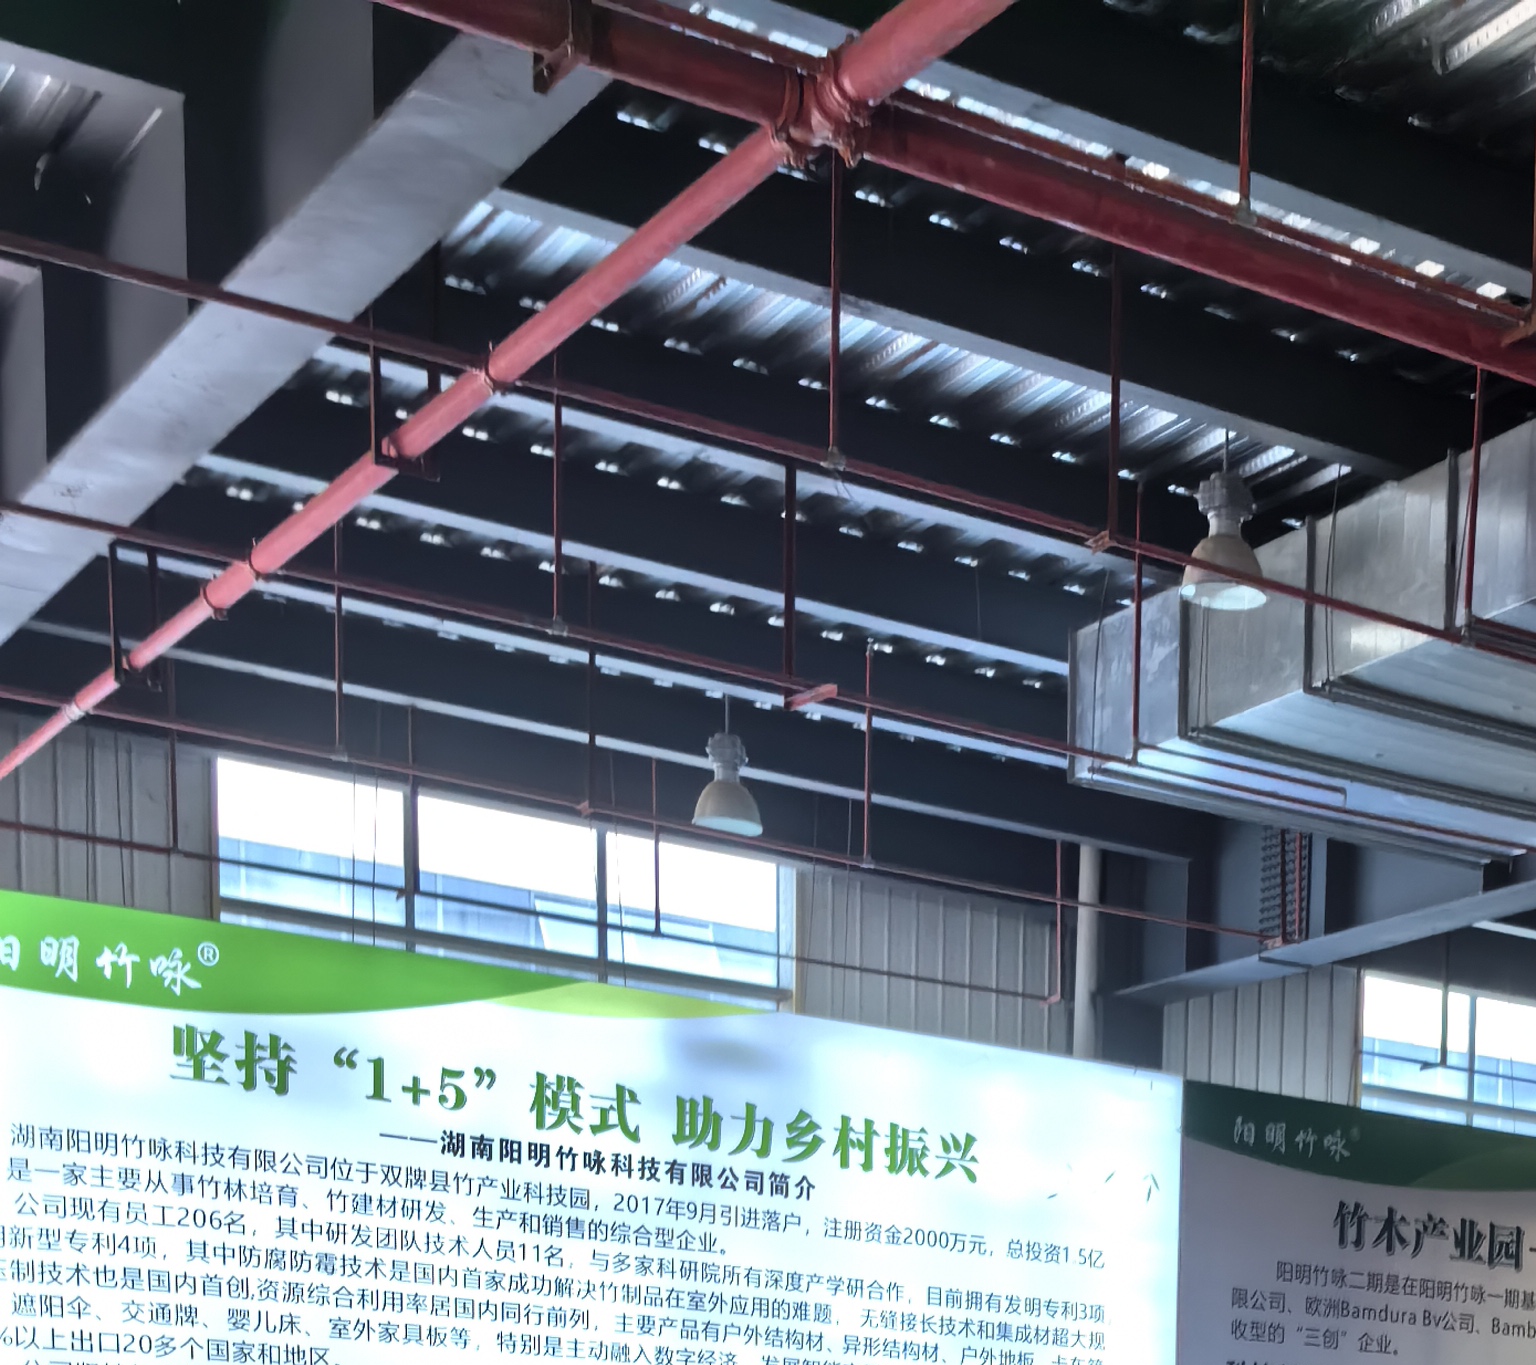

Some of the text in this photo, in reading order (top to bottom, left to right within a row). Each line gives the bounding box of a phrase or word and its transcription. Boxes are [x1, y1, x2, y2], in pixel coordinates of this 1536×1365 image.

[672, 1095, 980, 1184] 助力乡村振兴
